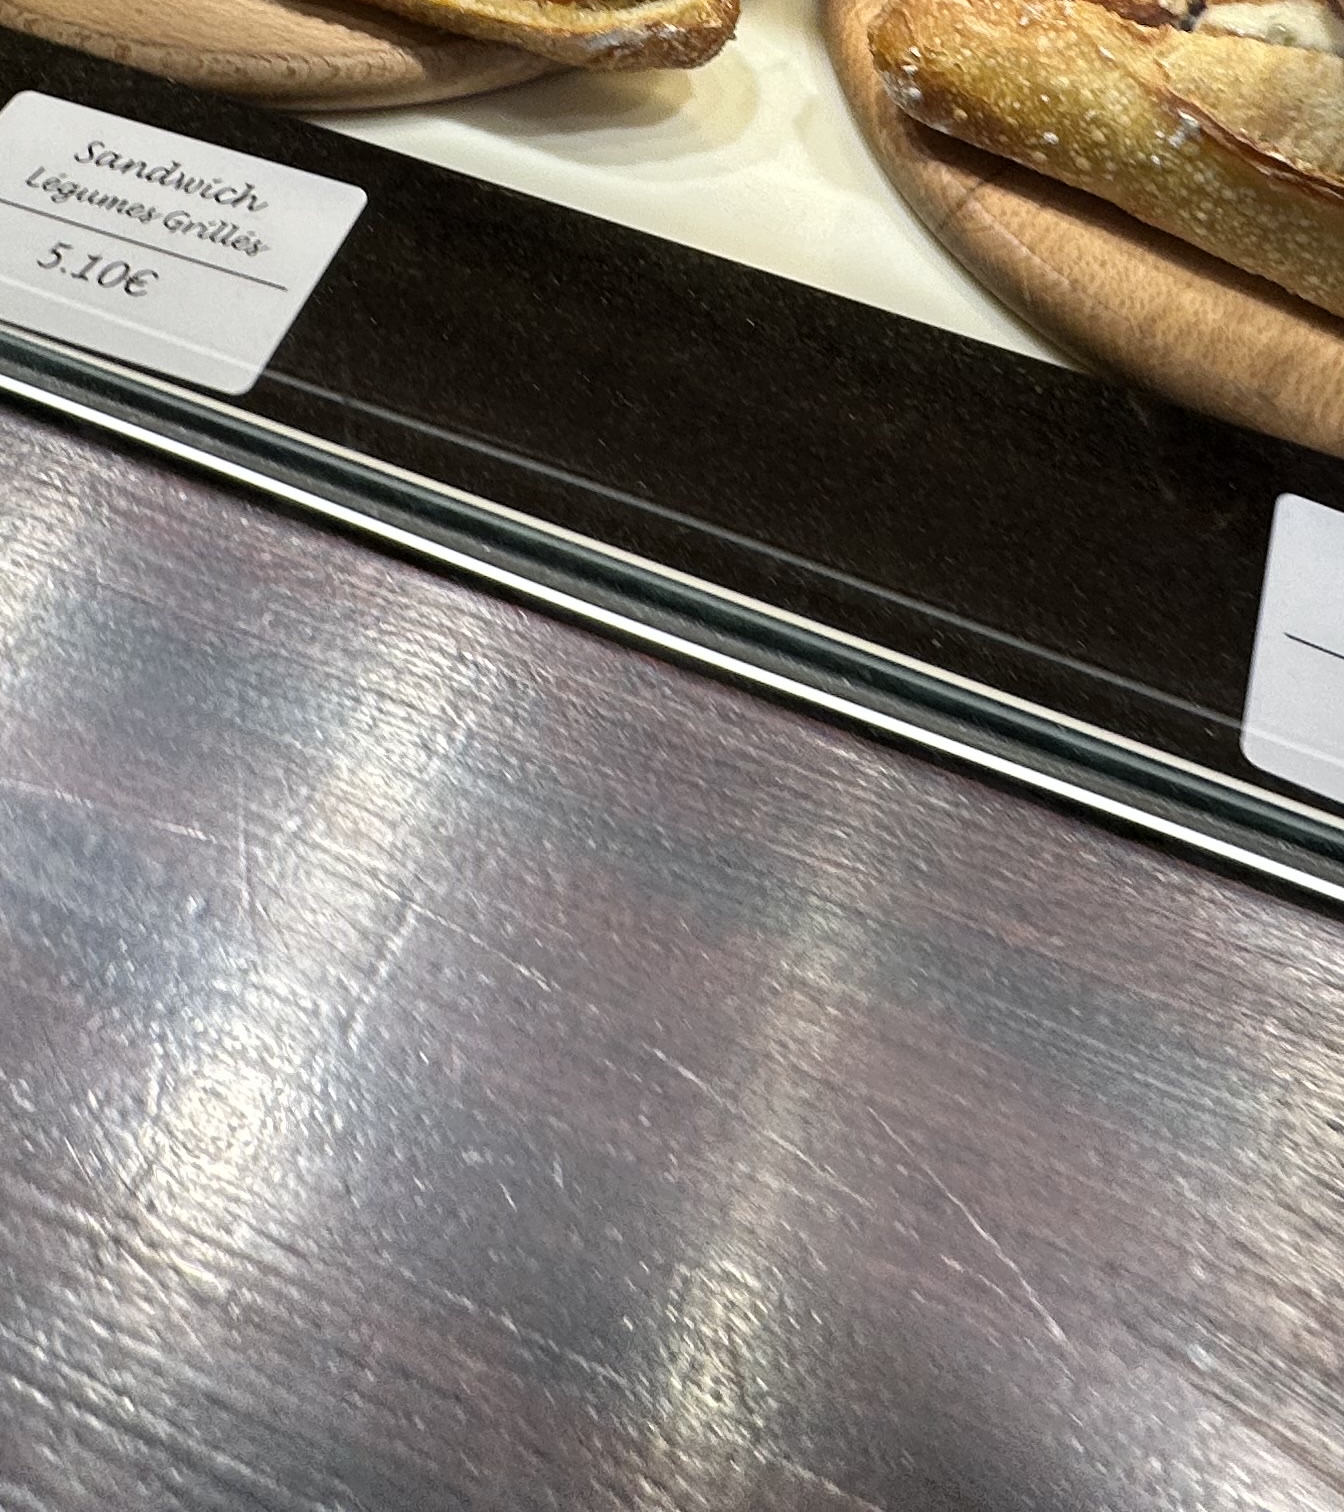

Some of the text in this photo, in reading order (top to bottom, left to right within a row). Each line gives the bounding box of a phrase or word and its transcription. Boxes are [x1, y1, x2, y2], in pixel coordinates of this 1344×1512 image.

[26, 166, 271, 257] Légumes Grillés
[74, 140, 269, 212] Sandwich
[36, 241, 160, 297] 5.10€
